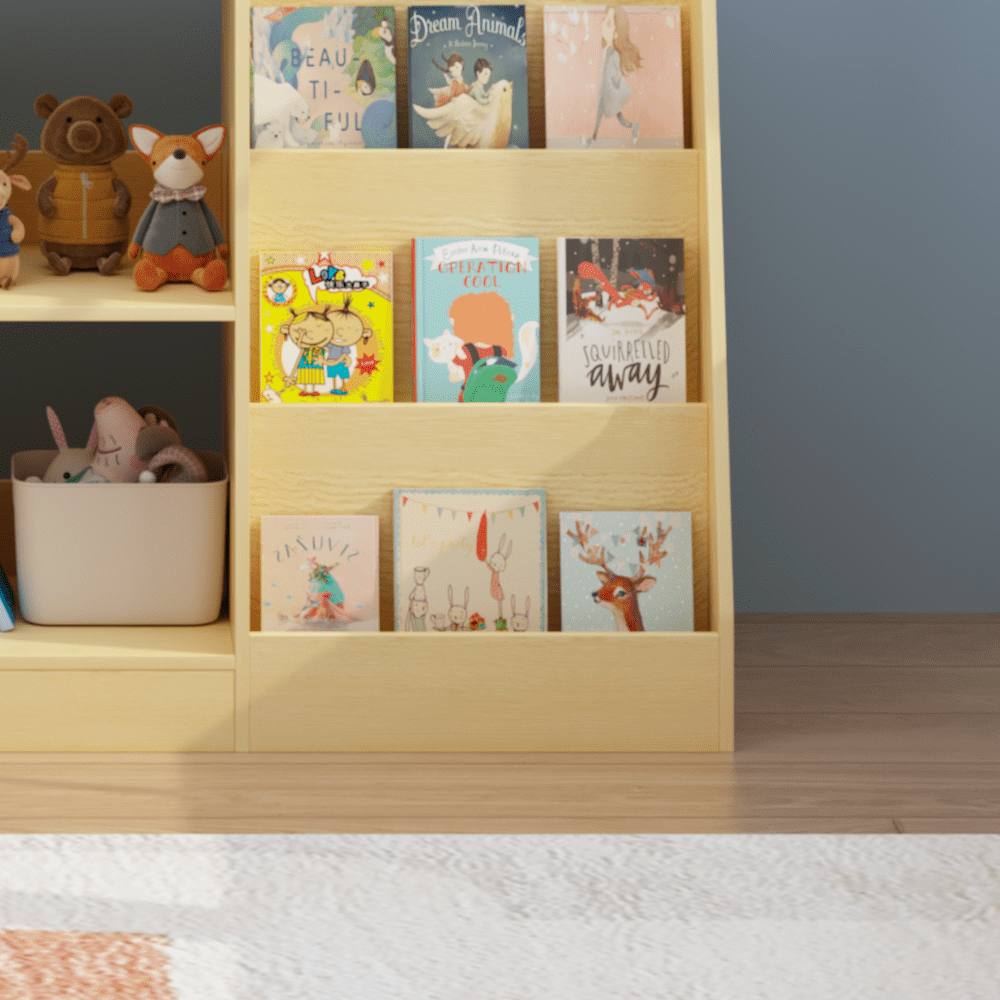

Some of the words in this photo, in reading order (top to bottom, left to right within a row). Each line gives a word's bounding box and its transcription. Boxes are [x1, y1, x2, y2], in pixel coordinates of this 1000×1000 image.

[409, 10, 462, 48] Dream
[465, 4, 526, 47] Animals
[291, 47, 360, 68] BEAU-
[309, 80, 341, 99] TI-
[324, 112, 361, 132] FUL
[437, 260, 528, 275] OPERATION
[463, 274, 501, 288] COOL
[583, 339, 671, 368] SQUIRRELLED
[586, 362, 670, 402] away
